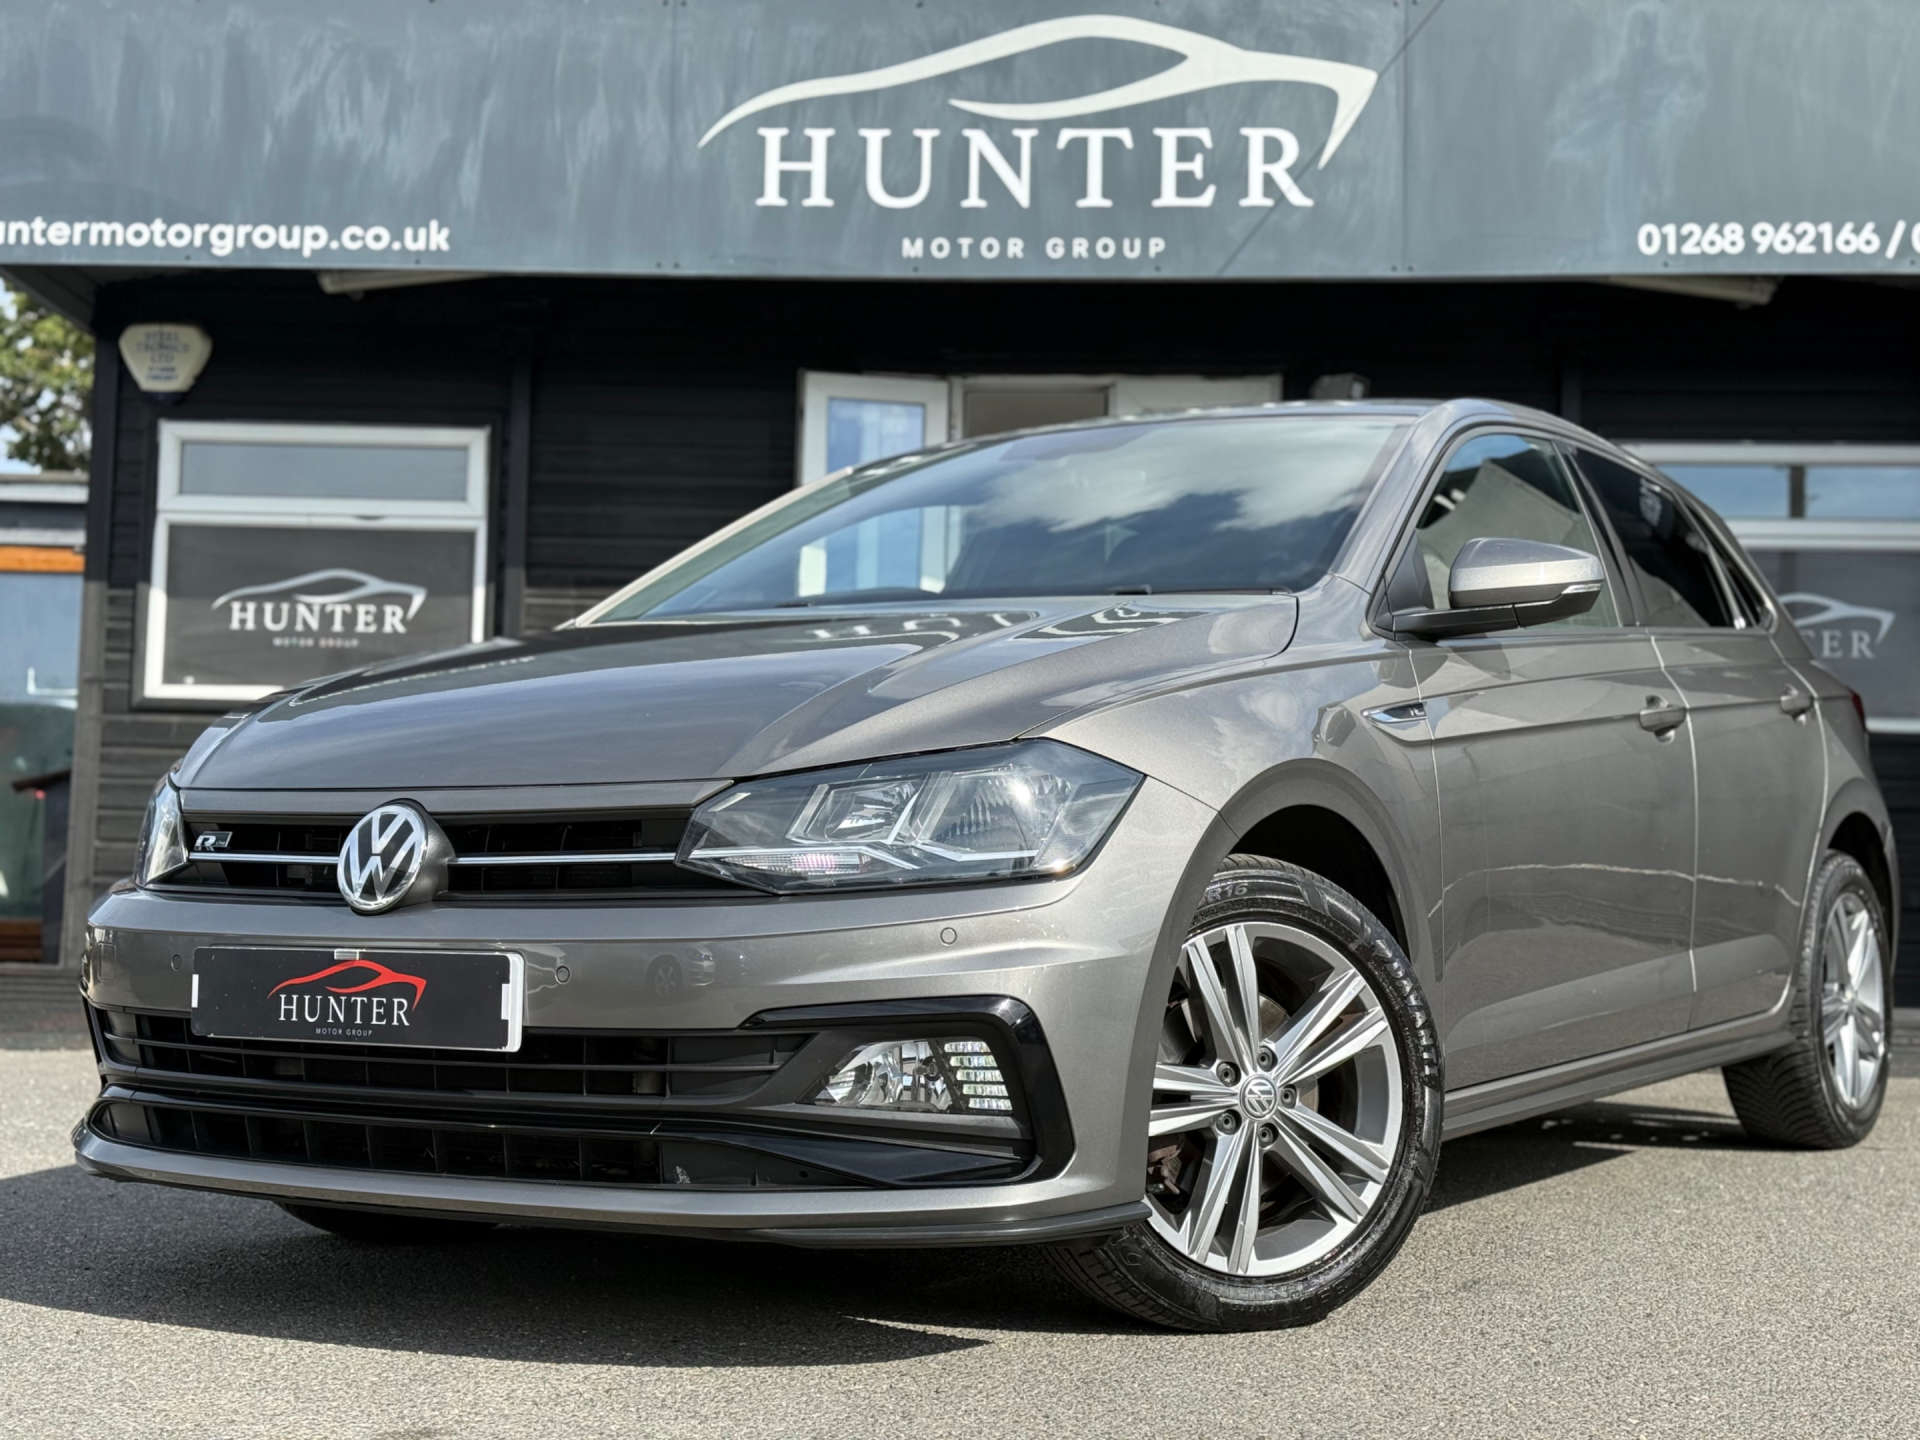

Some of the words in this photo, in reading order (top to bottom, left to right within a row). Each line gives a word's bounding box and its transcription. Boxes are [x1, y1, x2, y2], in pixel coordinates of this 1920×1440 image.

[756, 126, 1315, 209] HUNTER
[0, 216, 450, 257] ntermotorgroup.co.uk
[902, 237, 1025, 259] MOTOR
[1046, 237, 1166, 259] GROUP
[1637, 222, 1745, 255] 01268
[1751, 221, 1880, 254] 962166
[229, 602, 407, 634] HUNTER
[278, 994, 410, 1026] HUNTER
